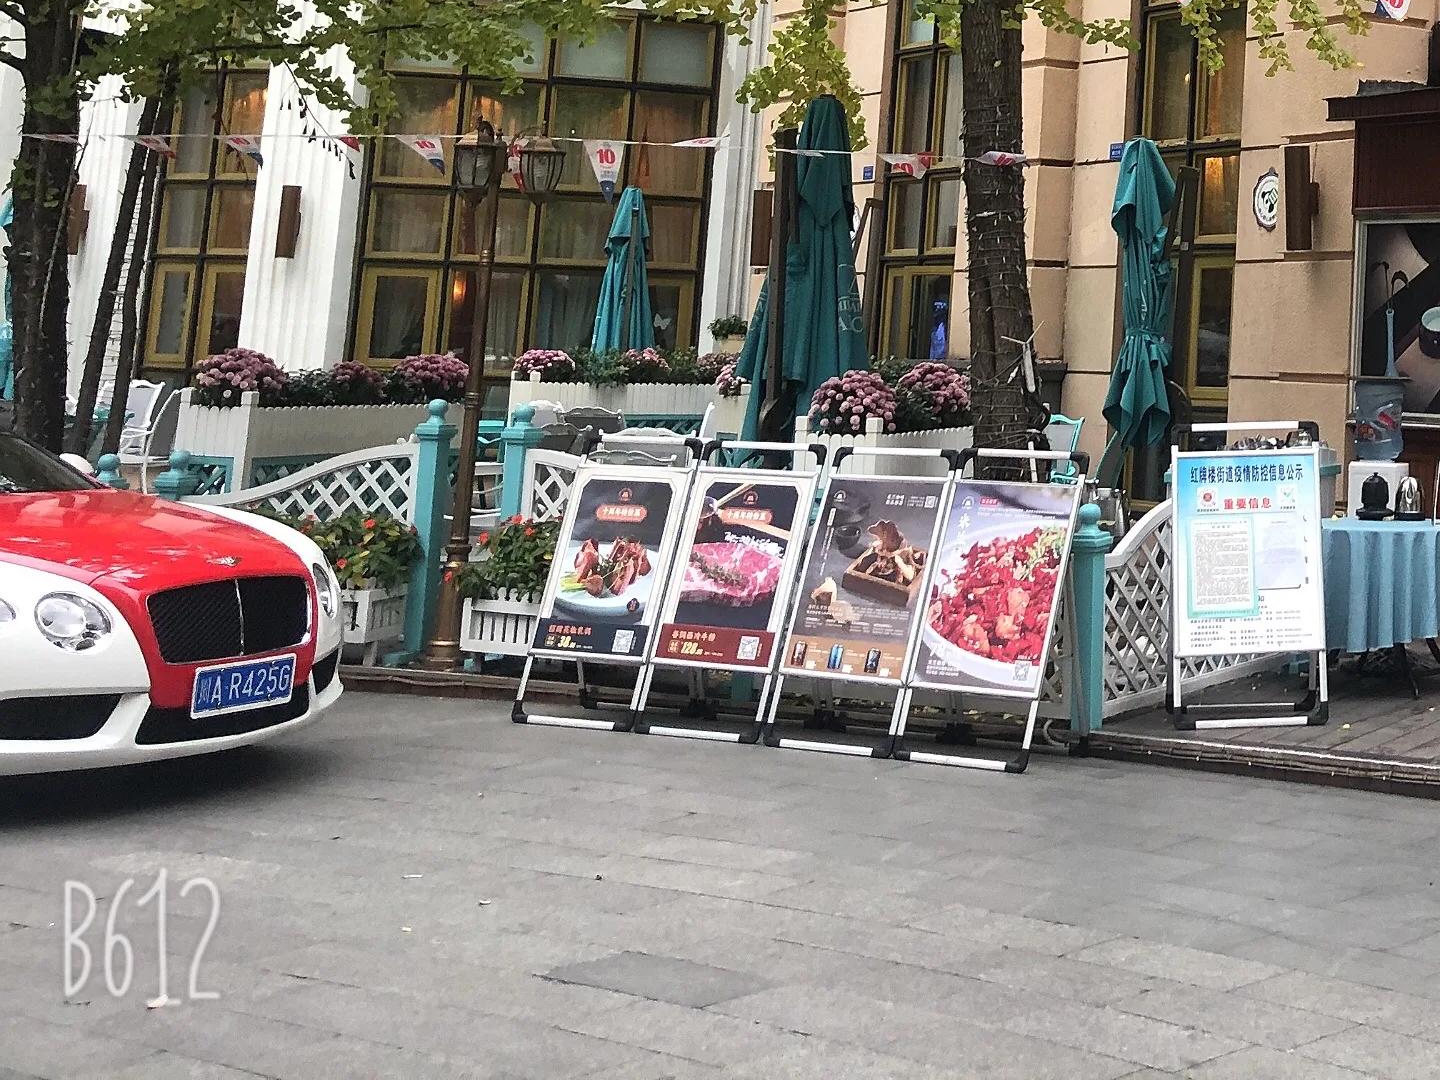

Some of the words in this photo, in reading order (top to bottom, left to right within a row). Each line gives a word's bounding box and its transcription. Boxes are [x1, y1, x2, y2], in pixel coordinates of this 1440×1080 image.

[597, 149, 616, 165] 10
[1190, 463, 1303, 483] 红牌楼街道疫情防控信息公示
[1223, 497, 1272, 510] 重要信息
